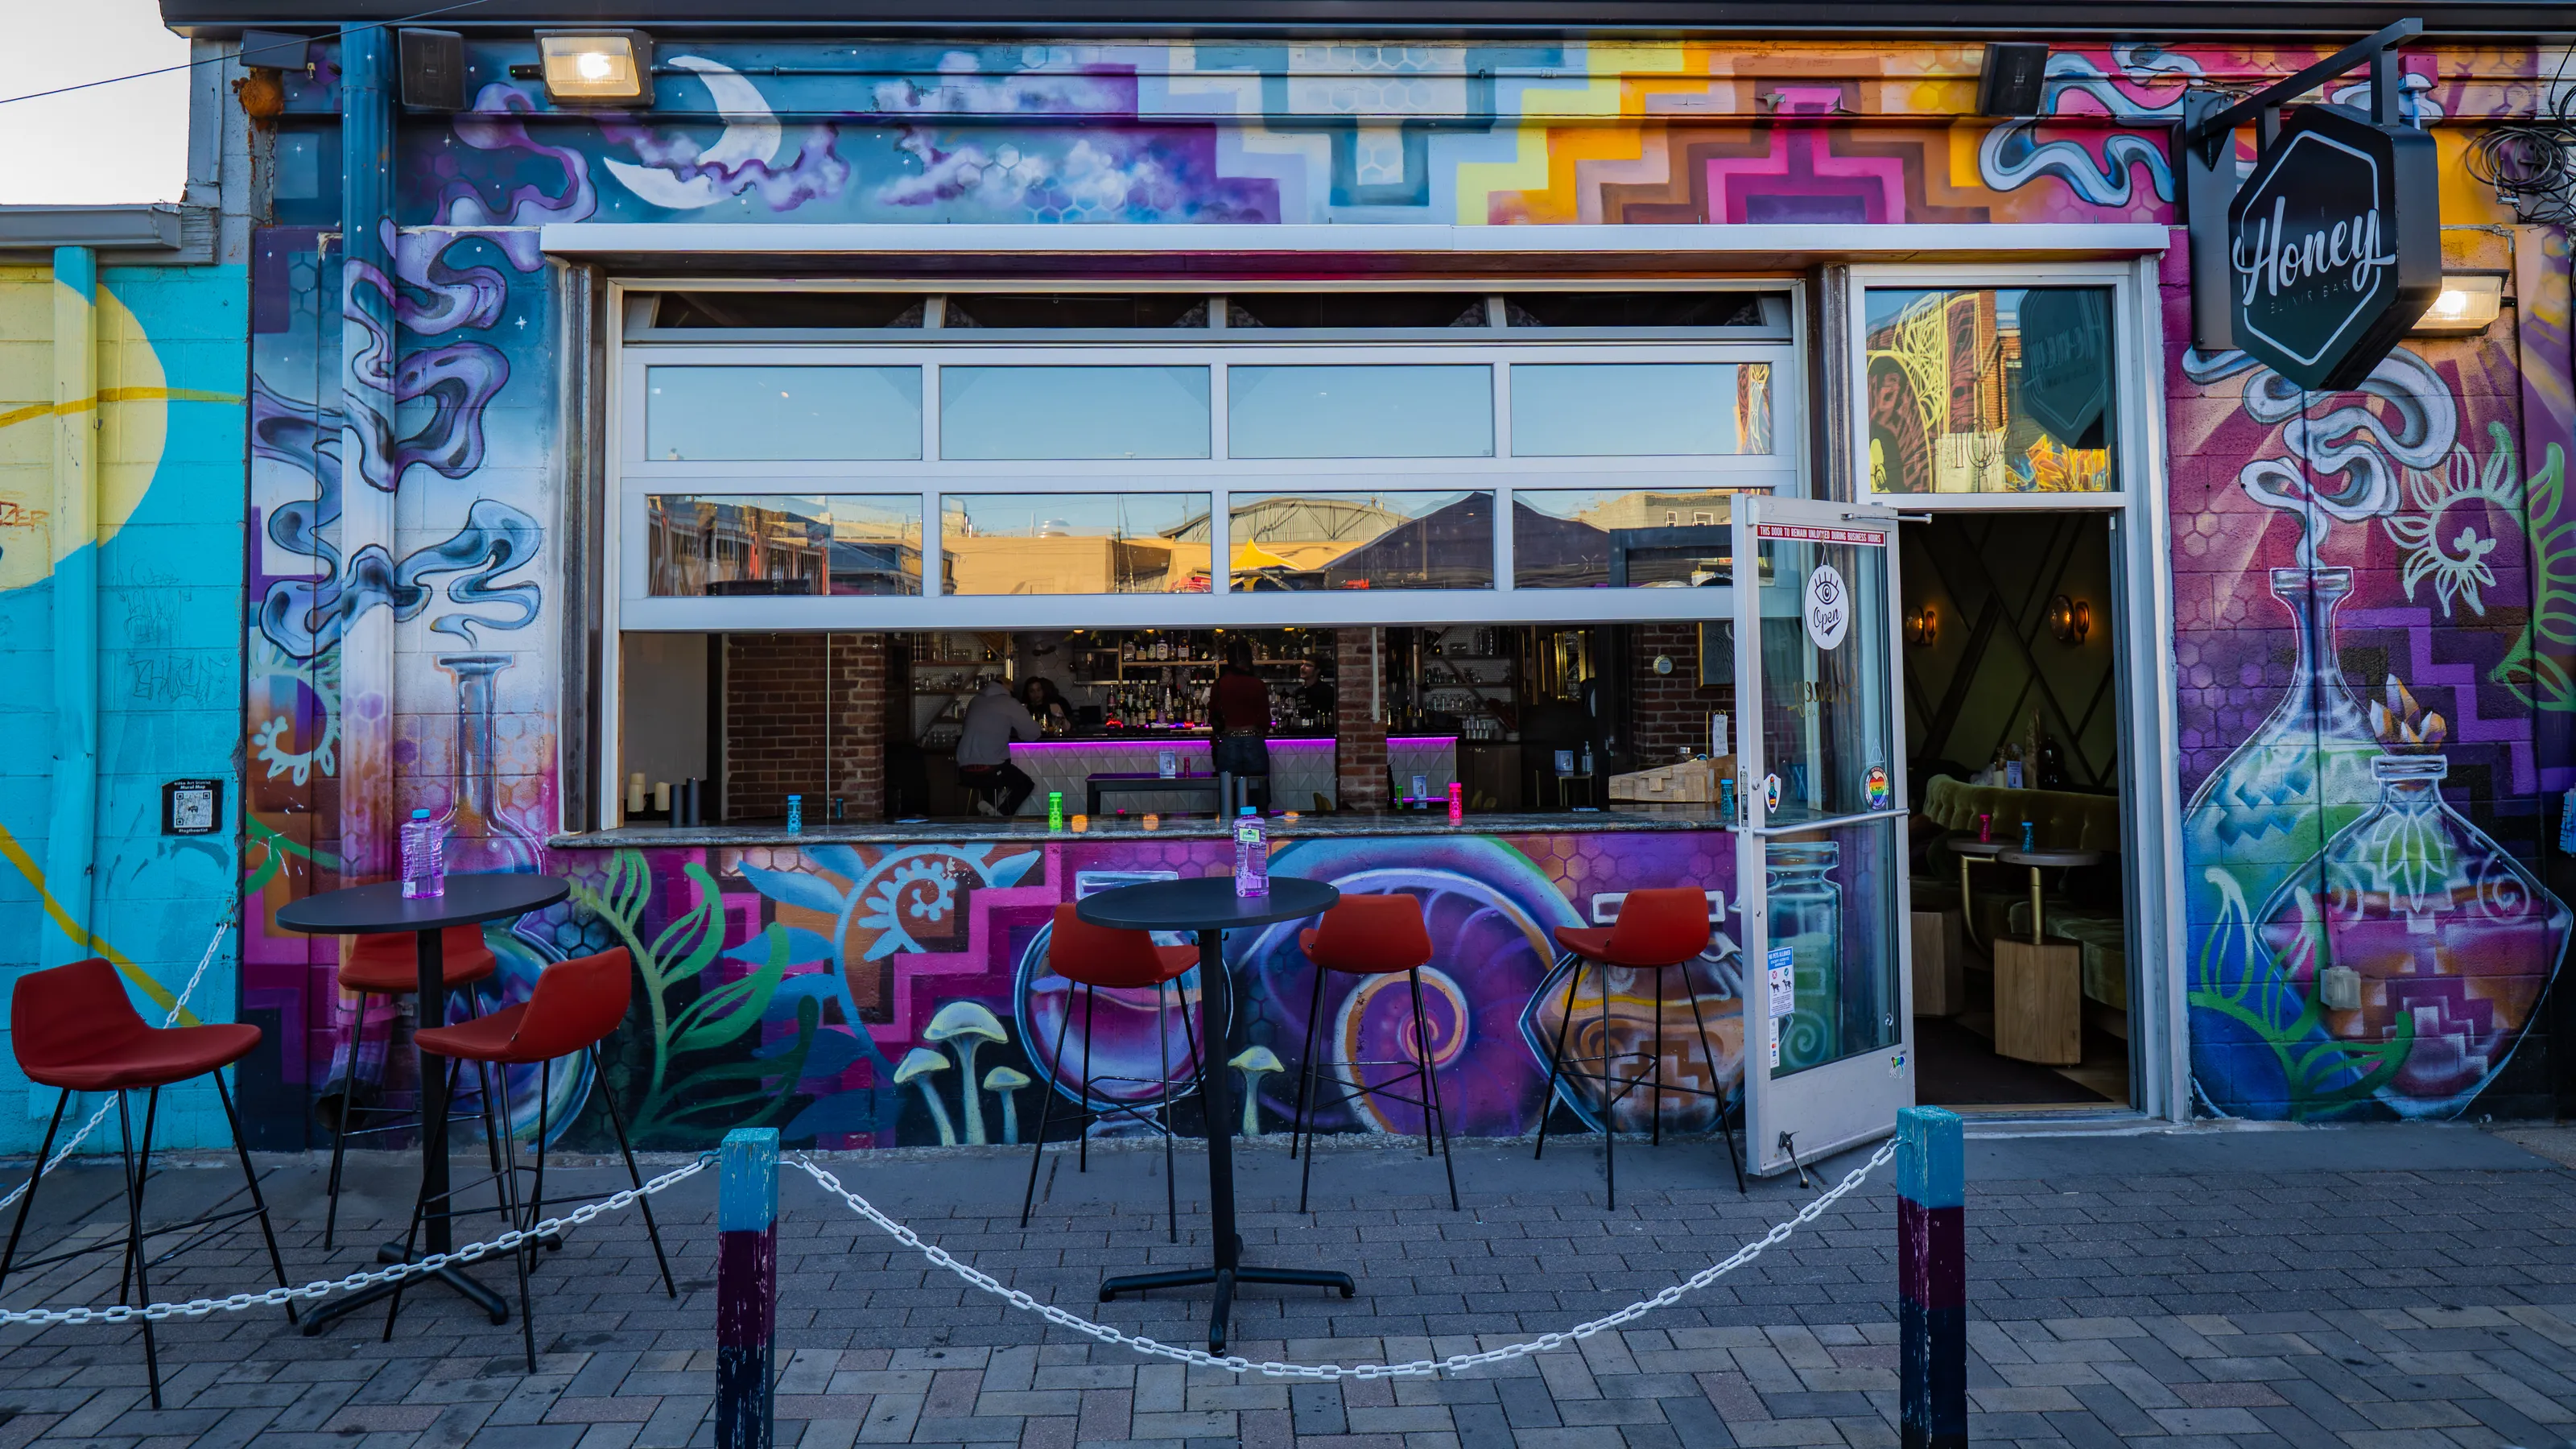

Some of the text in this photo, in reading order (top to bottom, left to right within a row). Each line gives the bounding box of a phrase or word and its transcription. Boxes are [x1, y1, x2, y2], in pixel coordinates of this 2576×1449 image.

[2232, 196, 2396, 306] Honey
[2270, 279, 2349, 314] ELIXIR BAR
[1760, 526, 1770, 536] THIS
[1771, 526, 1783, 537] DOOR
[1784, 527, 1790, 537] TO
[1790, 528, 1808, 538] REMAIN
[1831, 530, 1847, 540] DURING
[1847, 532, 1868, 542] BUSINESS
[1868, 534, 1881, 543] HOURS
[1813, 606, 1842, 636] Open
